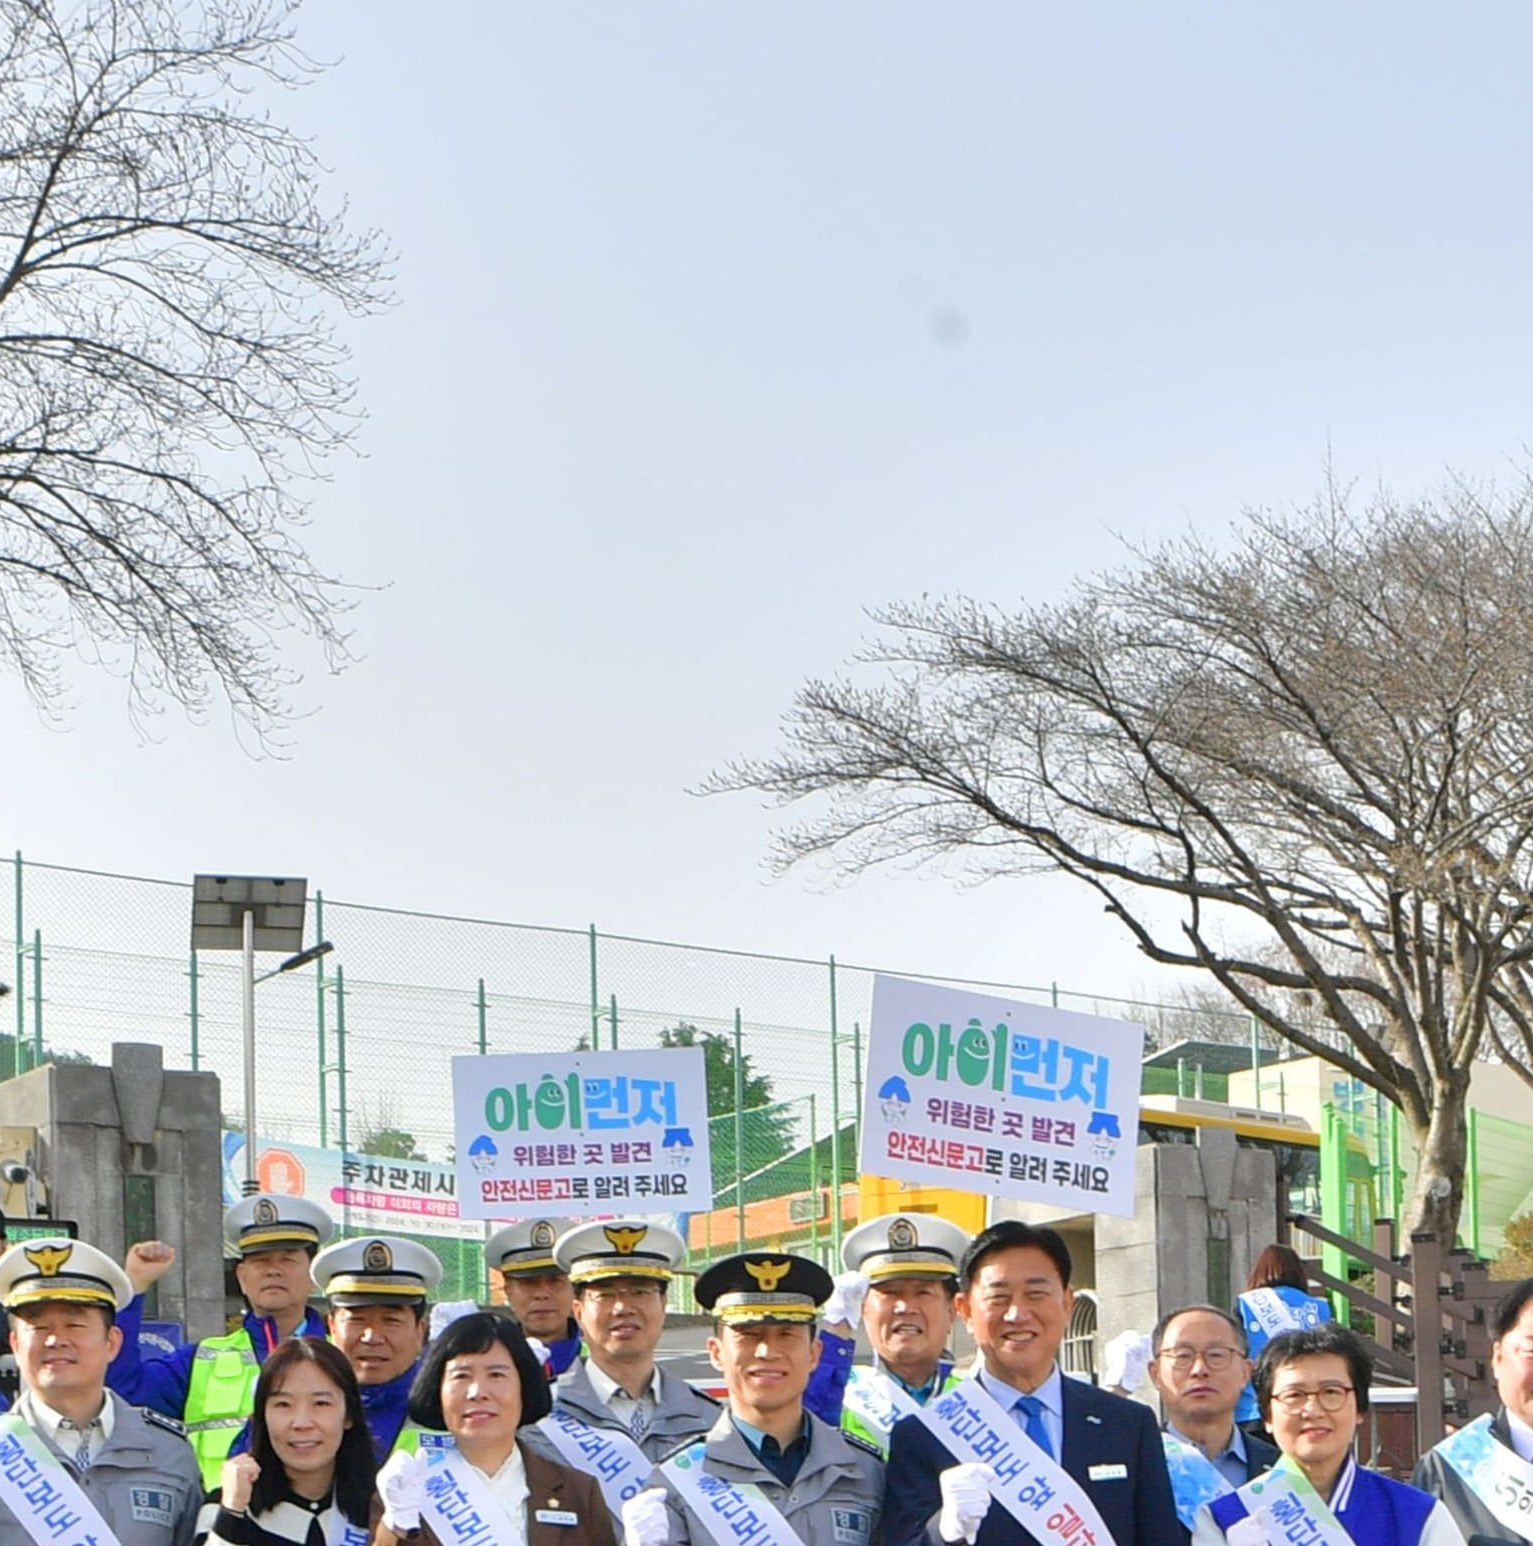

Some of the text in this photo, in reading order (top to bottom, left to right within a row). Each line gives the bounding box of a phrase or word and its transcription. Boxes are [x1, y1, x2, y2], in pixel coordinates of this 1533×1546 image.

[902, 1018, 1110, 1109] 아이먼저
[485, 1072, 677, 1132] 아이먼저
[926, 1097, 1076, 1147] 위험한 곳 발견
[513, 1141, 653, 1167] 위험한 곳 발견
[887, 1131, 1109, 1194] 안전신문고로 알려 주세요
[482, 1173, 688, 1203] 안전신문고로 알려 주세요
[935, 1392, 1030, 1487] 횡단보도
[1018, 1476, 1057, 1512] 앞
